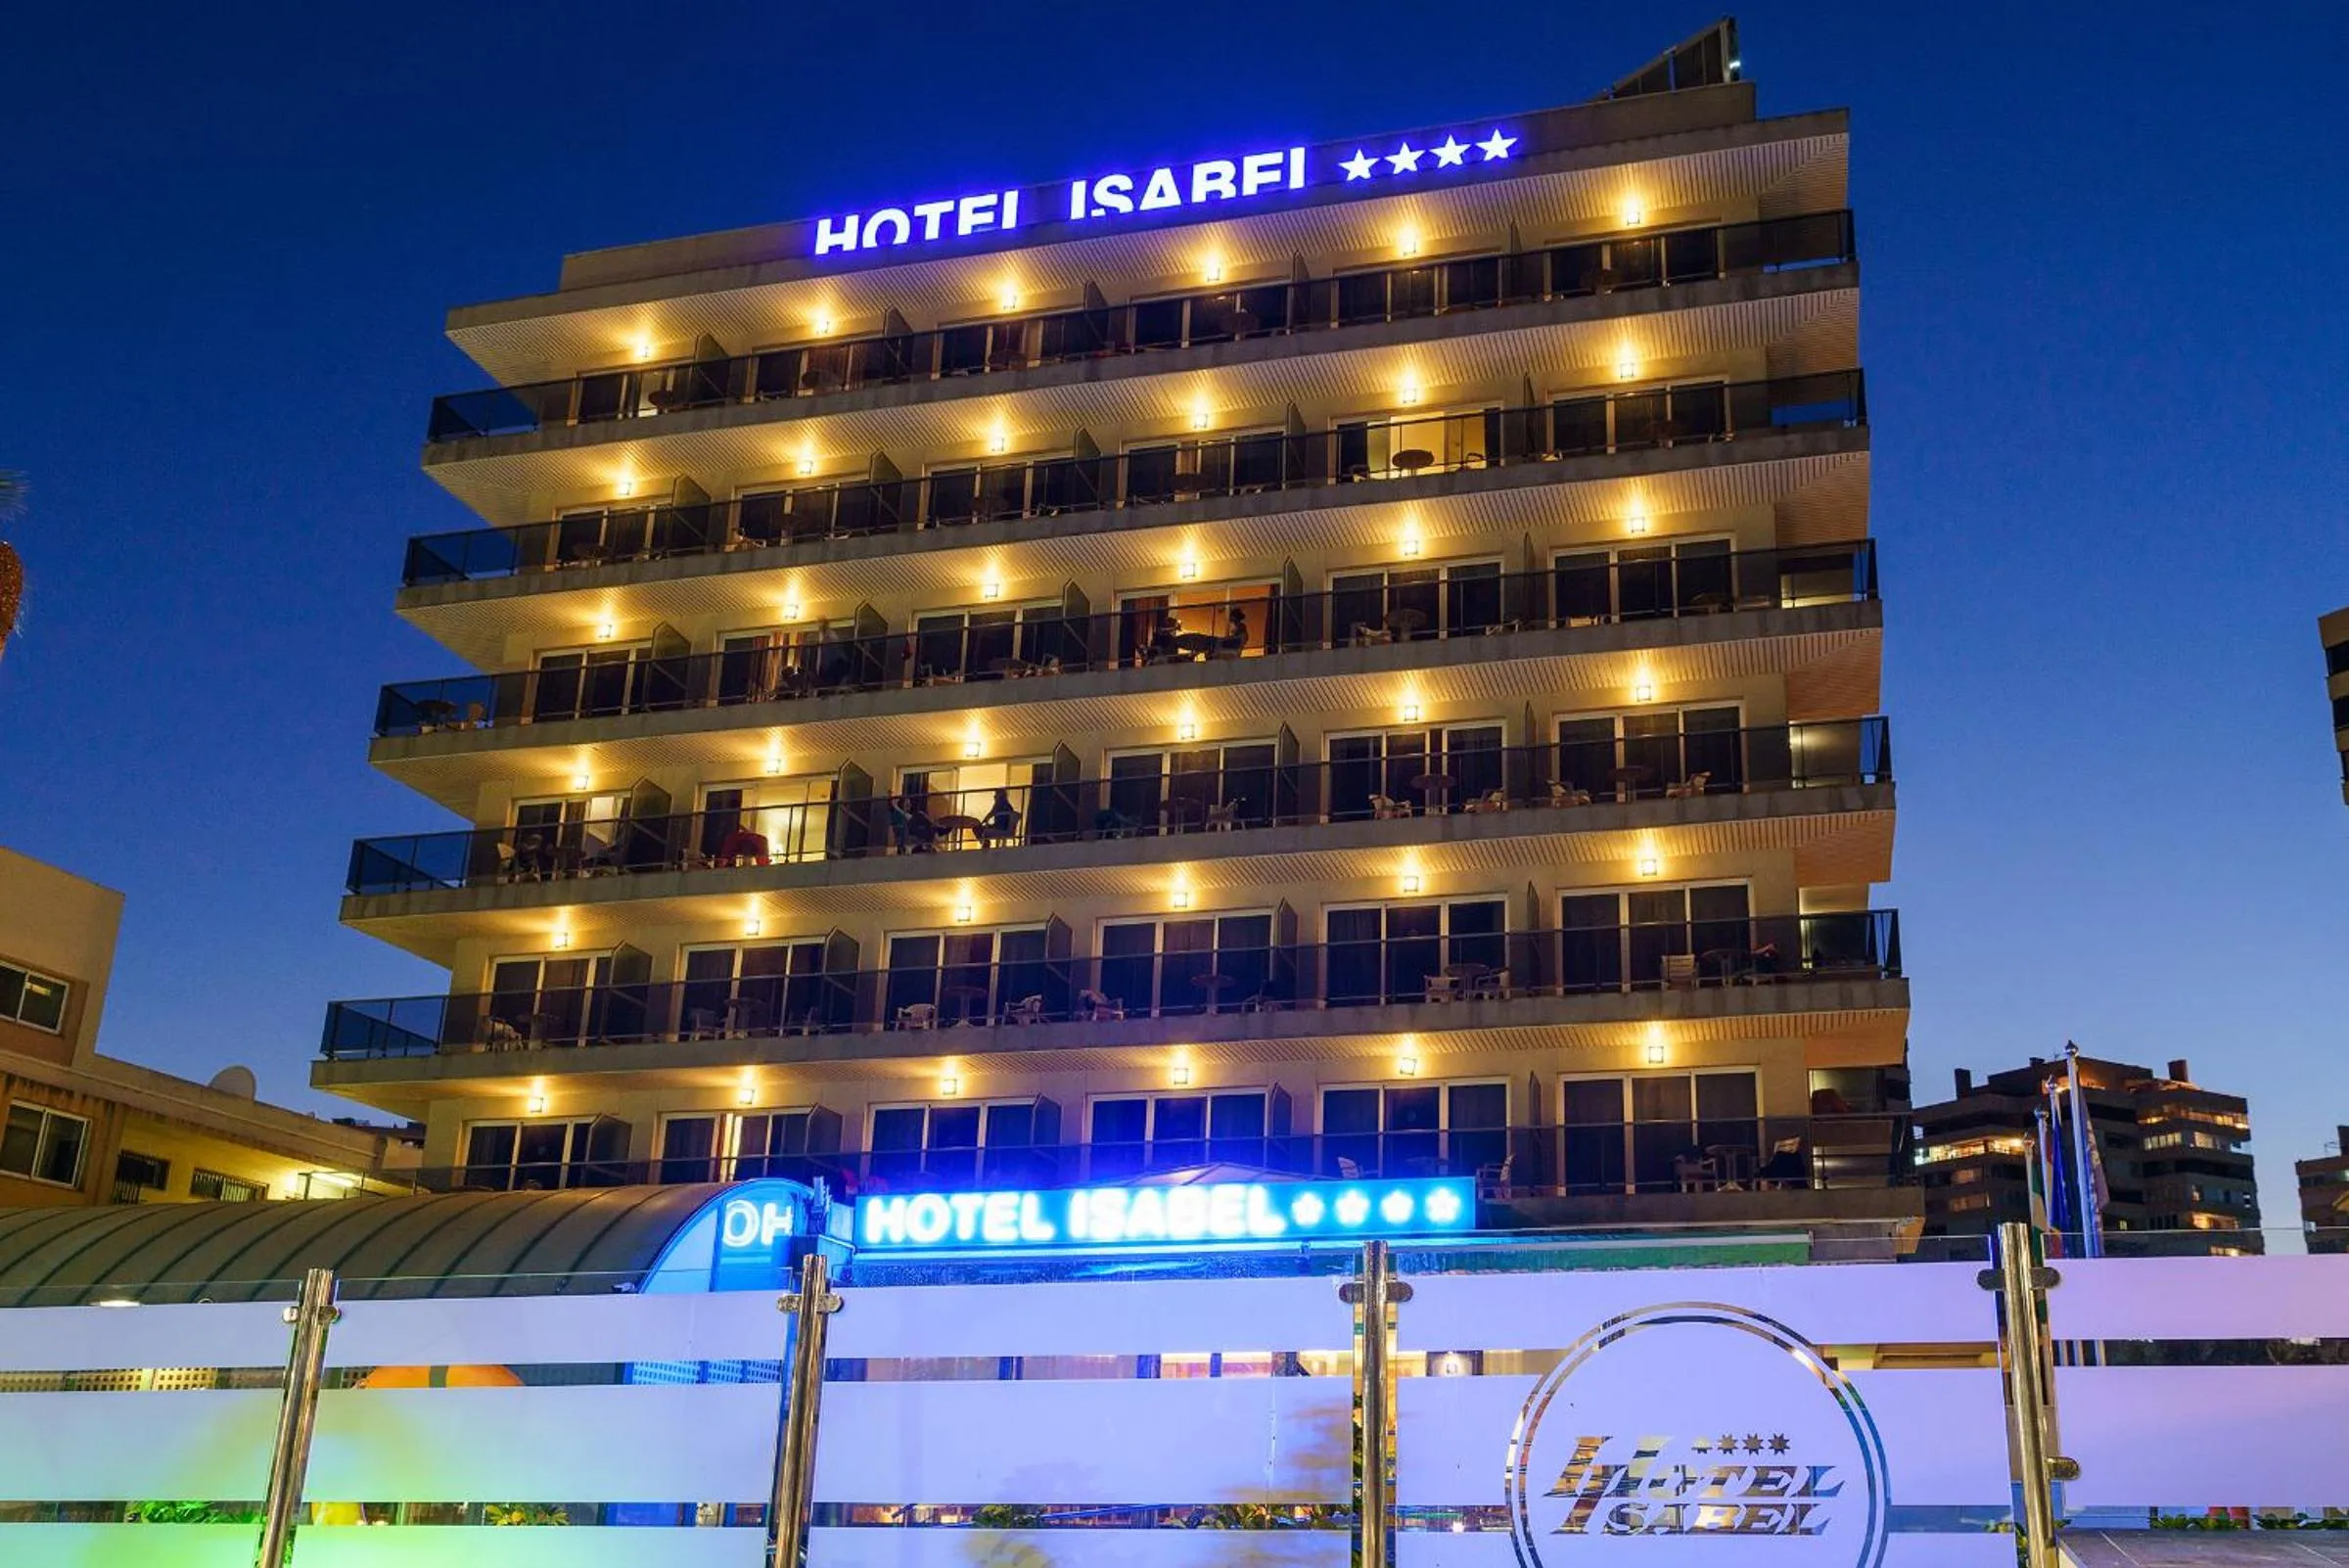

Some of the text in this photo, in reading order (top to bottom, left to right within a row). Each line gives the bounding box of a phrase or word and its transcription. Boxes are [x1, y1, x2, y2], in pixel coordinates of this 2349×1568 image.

[814, 190, 1019, 254] HOTEL
[865, 1183, 1286, 1243] HOTEL ISABEL
[1543, 1436, 1847, 1498] HOTEL
[1550, 1478, 1832, 1535] ISABEL
